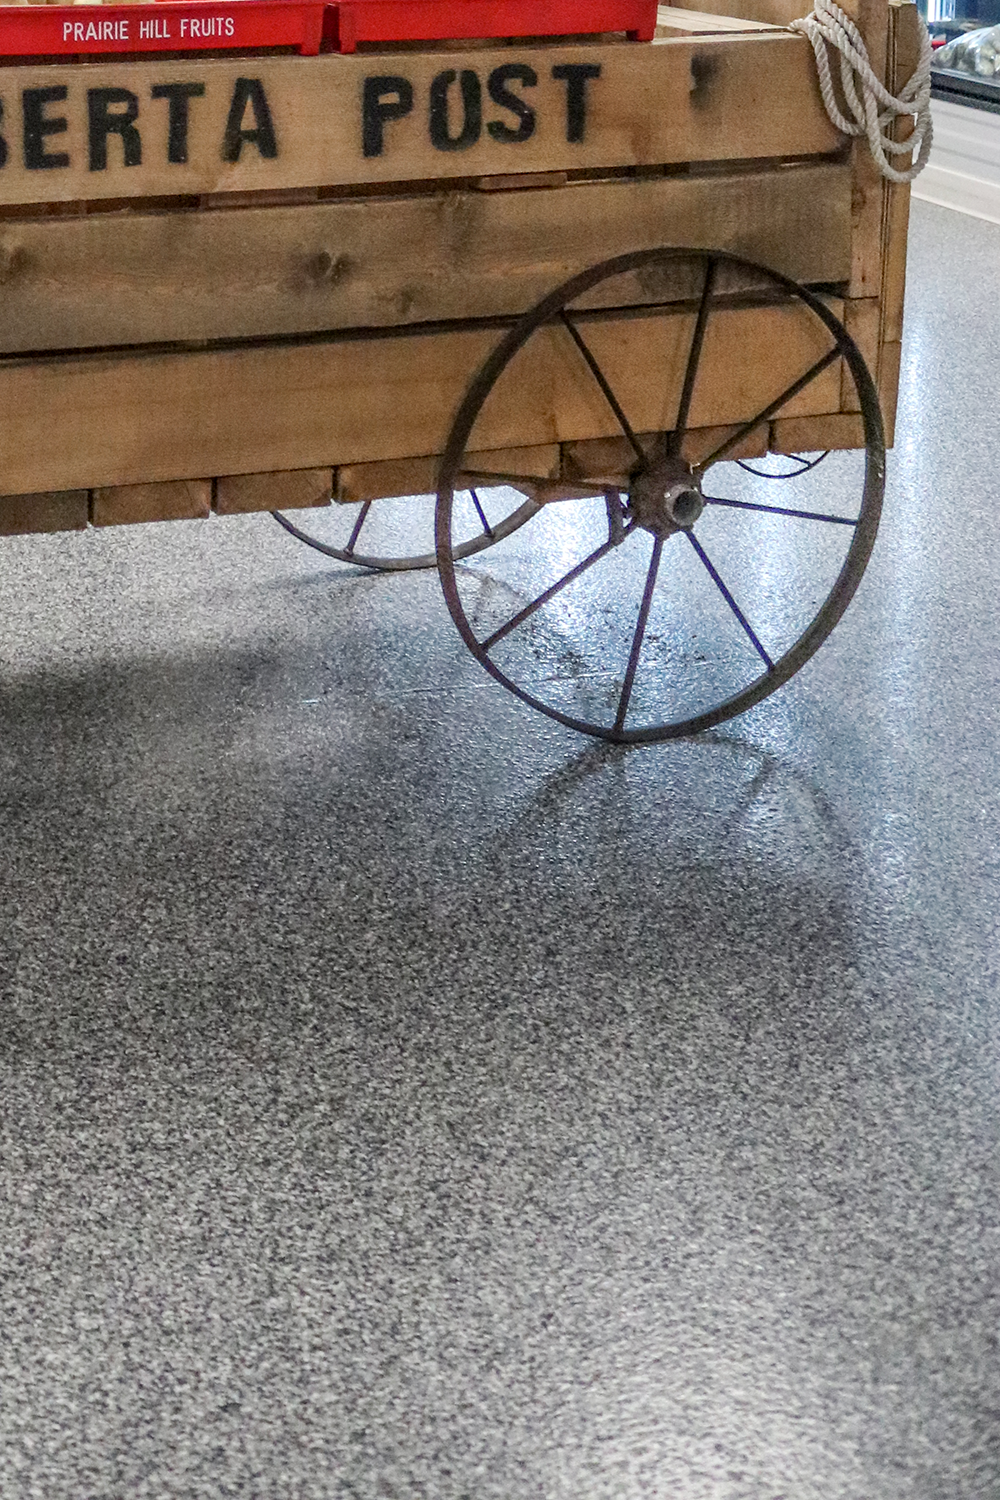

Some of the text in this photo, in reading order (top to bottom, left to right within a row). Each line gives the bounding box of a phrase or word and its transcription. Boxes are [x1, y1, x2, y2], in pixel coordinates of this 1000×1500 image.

[63, 17, 235, 41] PRAIRIE HILL FRUITS
[362, 63, 602, 158] POST
